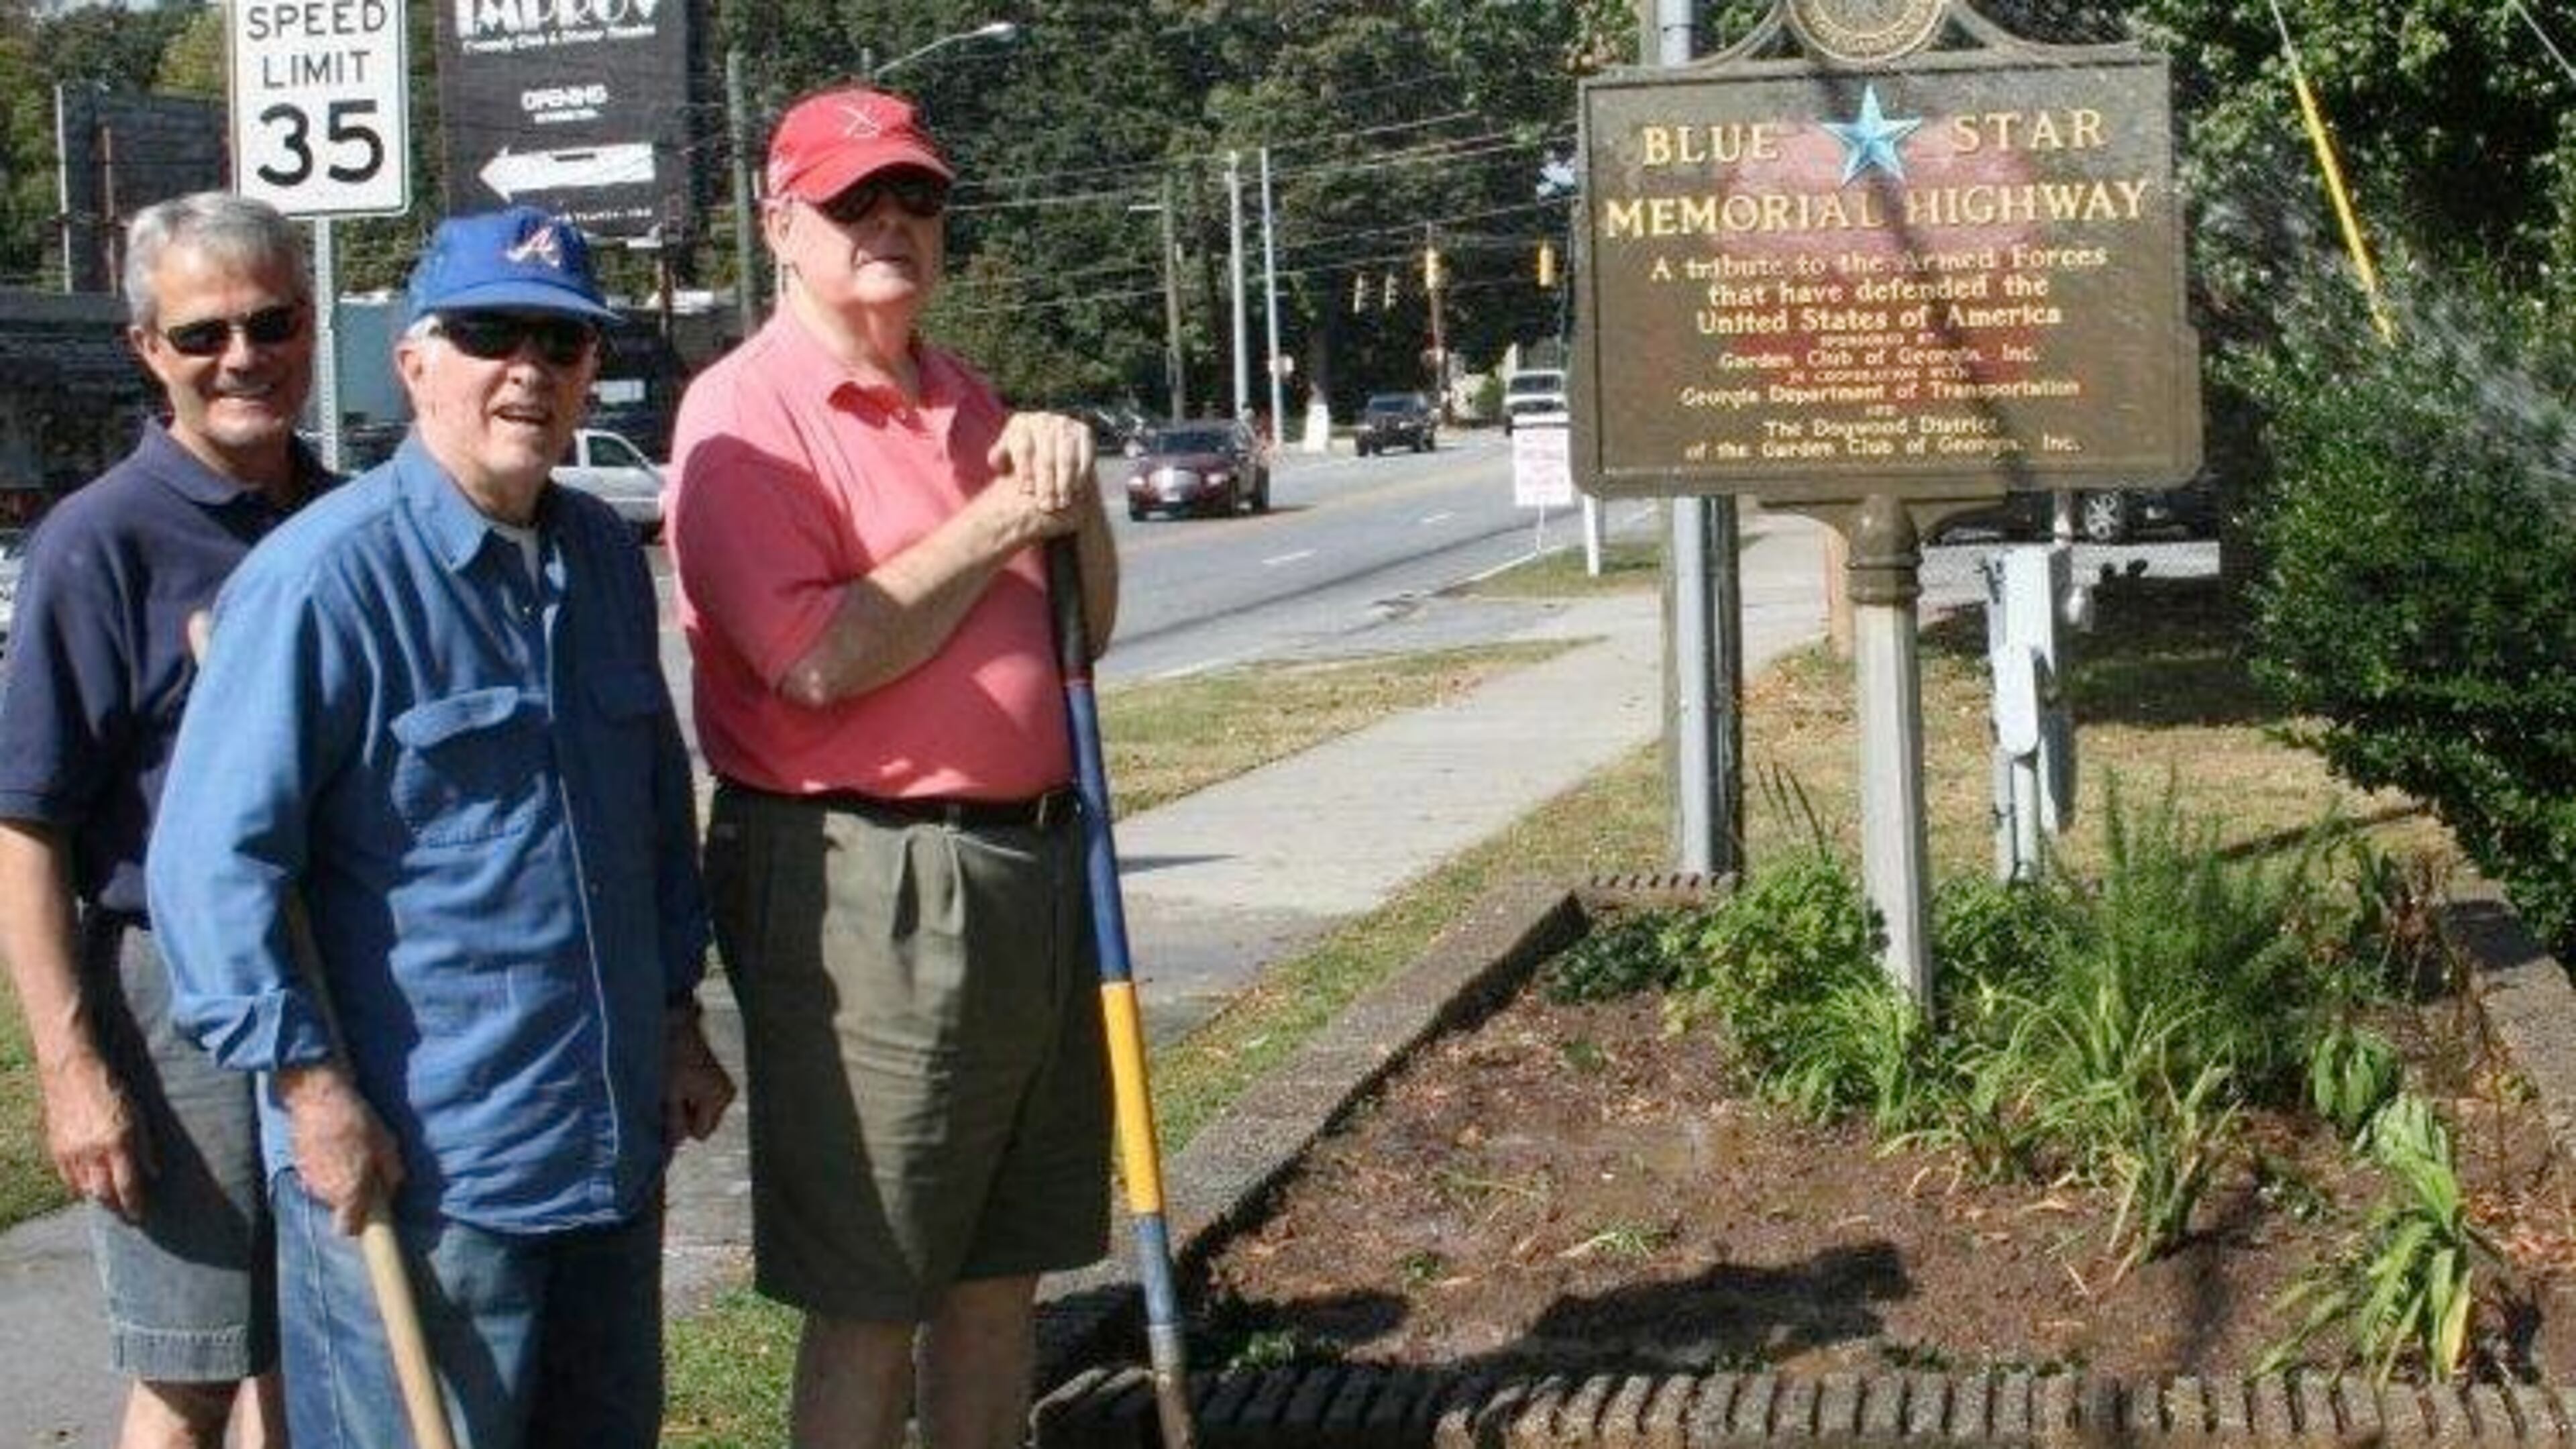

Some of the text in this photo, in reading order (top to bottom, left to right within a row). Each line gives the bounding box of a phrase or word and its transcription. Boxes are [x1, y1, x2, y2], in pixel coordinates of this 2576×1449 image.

[247, 0, 386, 40] SPEED
[264, 51, 370, 89] LIMIT
[521, 84, 608, 111] OPENING
[257, 99, 386, 186] 35
[1643, 109, 2105, 167] BLUE STAR
[1607, 179, 2147, 238] MEMORIAL HIGHWAY
[1651, 245, 2108, 281] A tribute to the Armed Forces
[1708, 274, 2049, 306] that have defended the
[1697, 303, 2062, 335] United States of America
[1719, 352, 1795, 371] Garden
[1807, 349, 1853, 367] Club
[1865, 347, 1887, 366] of
[2003, 342, 2039, 363] Inc.
[1680, 380, 2080, 410] Georgia Department of Transportation
[1762, 415, 1997, 440] The Dogwood District
[1684, 441, 1706, 460] of
[1717, 440, 1752, 459] the
[1762, 439, 1836, 458] Garden
[1847, 437, 1894, 455] Club
[1905, 436, 1926, 454] of
[2043, 433, 2085, 451] Inc.
